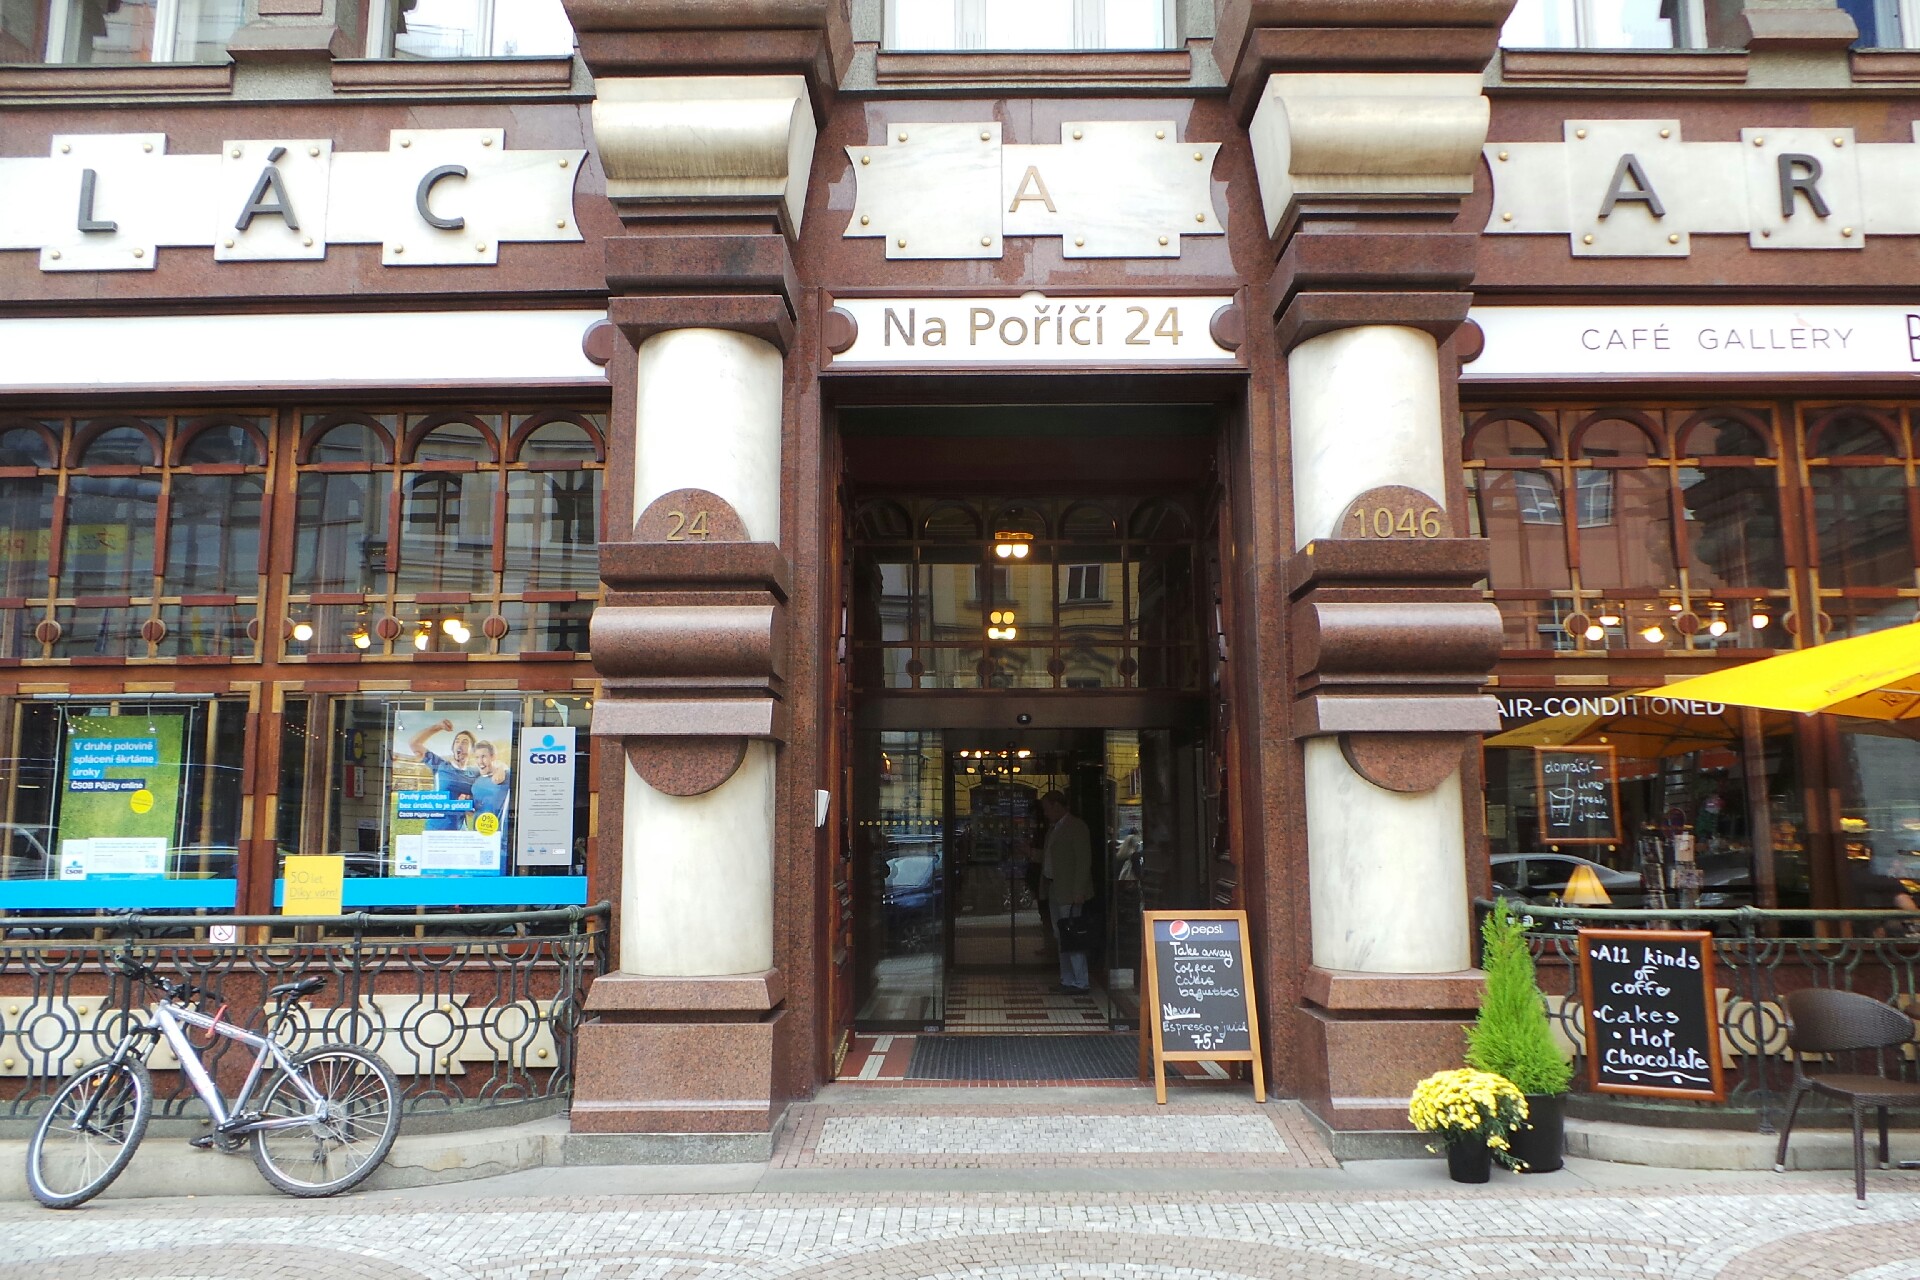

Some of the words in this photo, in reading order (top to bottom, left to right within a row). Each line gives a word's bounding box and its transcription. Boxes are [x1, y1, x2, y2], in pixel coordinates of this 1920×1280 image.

[1009, 165, 1057, 213] A
[883, 307, 947, 347] Na
[969, 304, 1105, 346] Poříčí
[1124, 305, 1184, 346] 24
[1581, 323, 1671, 350] CAFÉ
[1697, 326, 1854, 350] GALLERY
[666, 510, 710, 541] 24
[1353, 507, 1441, 538] 1046
[74, 742, 82, 751] V
[83, 741, 112, 751] druhé
[114, 742, 153, 752] polovině
[73, 755, 113, 765] splácení
[115, 754, 154, 764] škrtáme
[529, 752, 567, 765] ČSOB
[72, 768, 101, 778] úroky
[71, 780, 94, 789] ČSOB
[1191, 924, 1223, 936] pepsi
[1169, 941, 1200, 956] Take
[1201, 948, 1234, 968] away
[1643, 946, 1701, 970] kinds
[1174, 961, 1216, 978] Coffee
[1634, 965, 1660, 981] of
[1178, 986, 1240, 1001] baguettes
[1600, 1004, 1680, 1024] Cakes
[1162, 1021, 1211, 1037] Espresso
[1630, 1027, 1676, 1048] Hot
[1606, 1046, 1710, 1070] Chocolate
